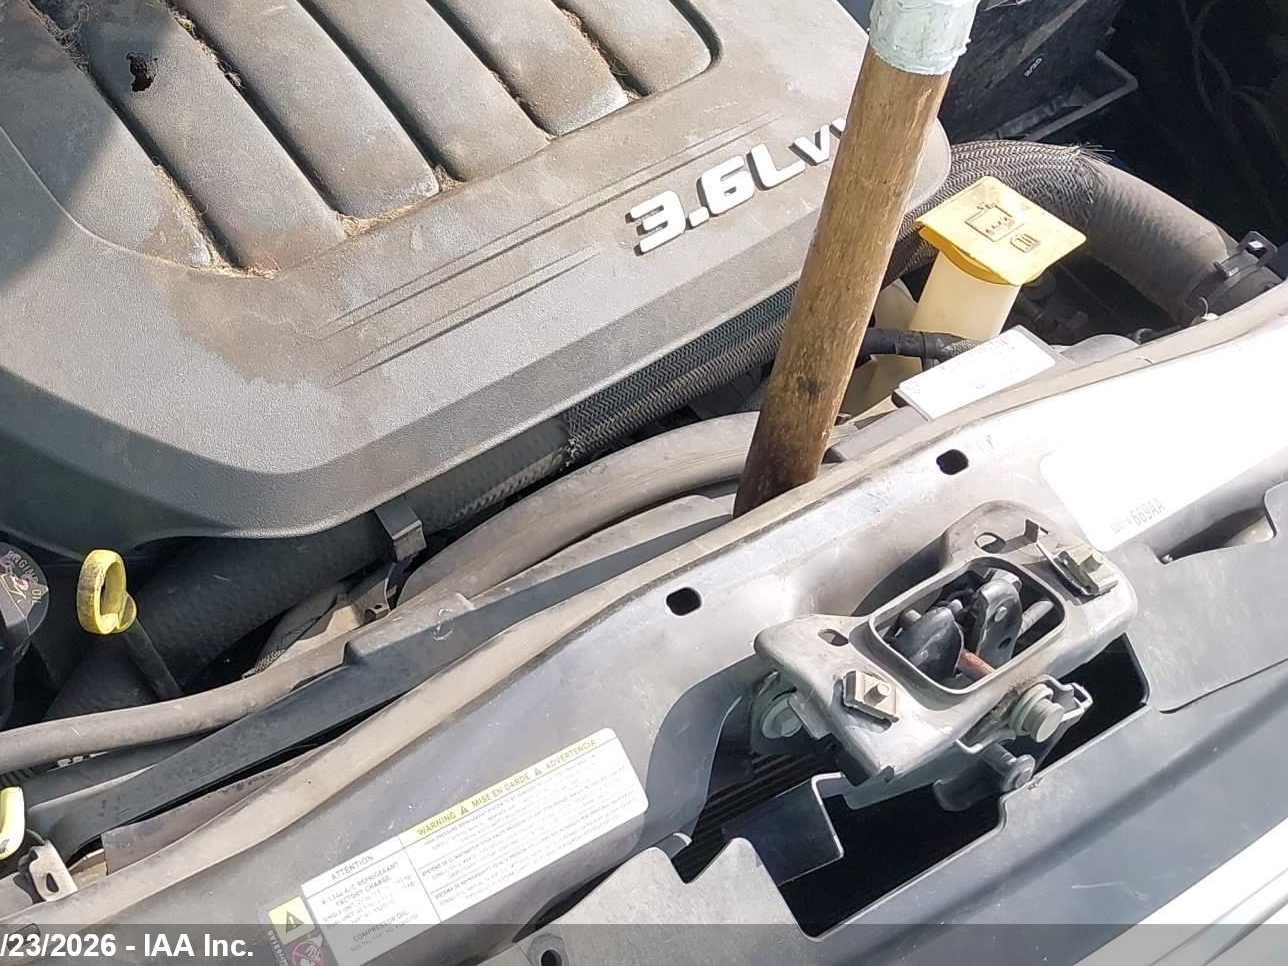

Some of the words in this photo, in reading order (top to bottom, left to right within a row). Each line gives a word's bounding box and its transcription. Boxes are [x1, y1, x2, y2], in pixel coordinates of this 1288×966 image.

[30, 588, 43, 605] OIL
[417, 811, 457, 836] WARNING
[471, 791, 493, 808] MISE
[492, 786, 503, 798] EN
[503, 772, 530, 793] GARDE
[545, 738, 596, 770] ADVERTENCIA
[331, 854, 374, 880] ATTENTION
